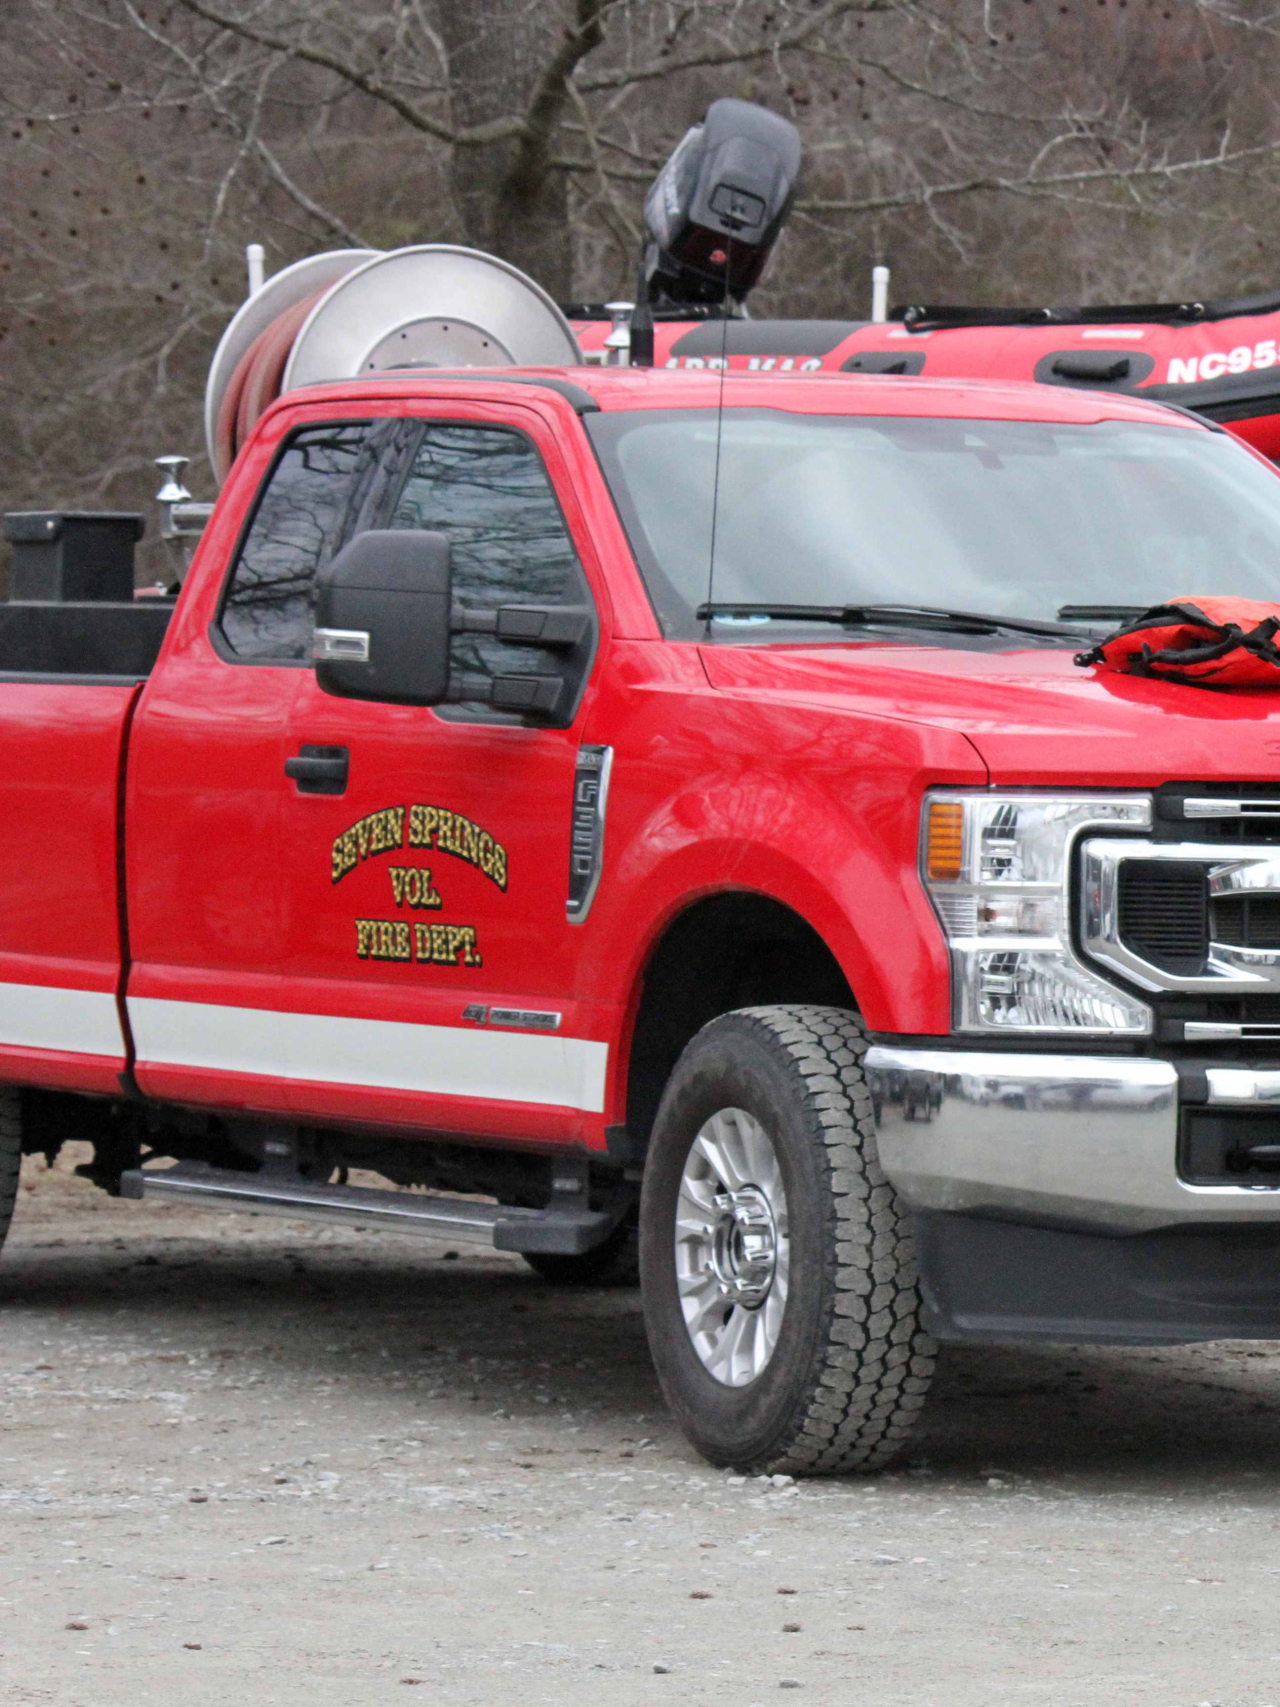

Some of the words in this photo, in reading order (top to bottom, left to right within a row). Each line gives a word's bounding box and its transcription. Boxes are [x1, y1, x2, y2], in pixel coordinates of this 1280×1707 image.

[332, 804, 406, 885] SEVEN
[408, 802, 508, 893] SPRINGS
[388, 866, 443, 910] VOL.
[355, 918, 412, 962] FIRE
[414, 922, 483, 967] DEPT.
